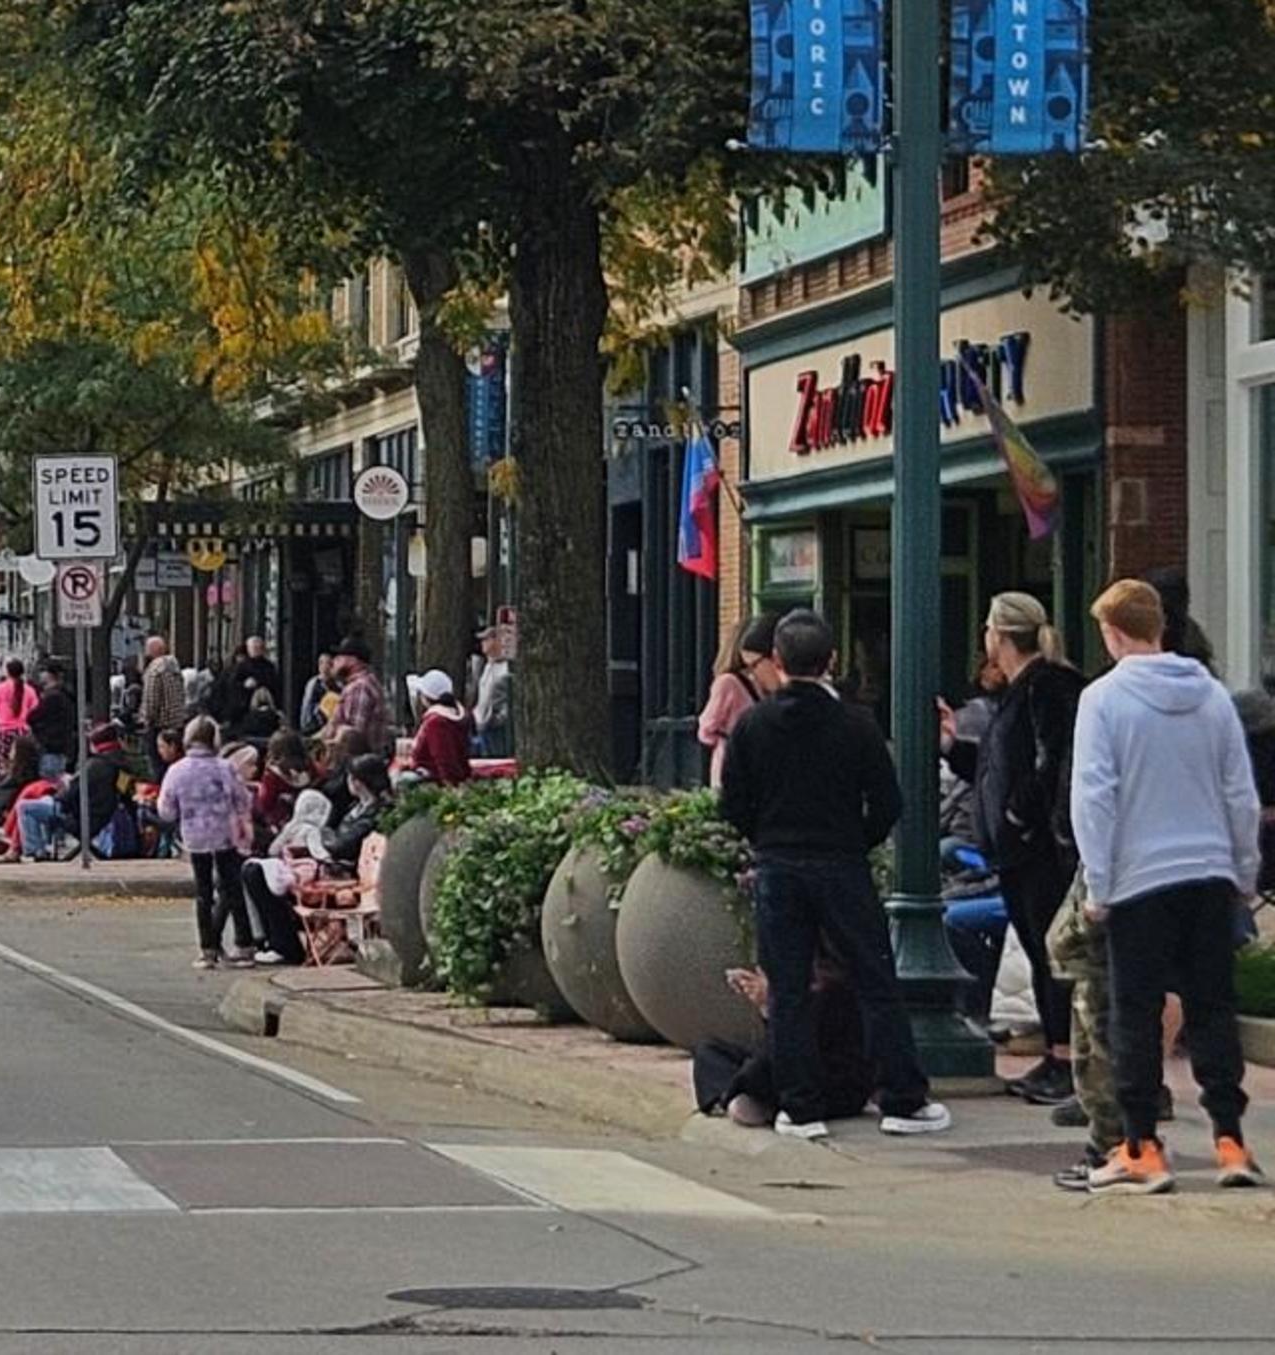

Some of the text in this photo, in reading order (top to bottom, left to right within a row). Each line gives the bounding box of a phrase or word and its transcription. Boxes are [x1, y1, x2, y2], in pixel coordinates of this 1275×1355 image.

[1008, 0, 1028, 124] NTOWN
[41, 467, 110, 484] SPEED
[49, 489, 102, 505] LIMIT
[52, 511, 101, 547] 15
